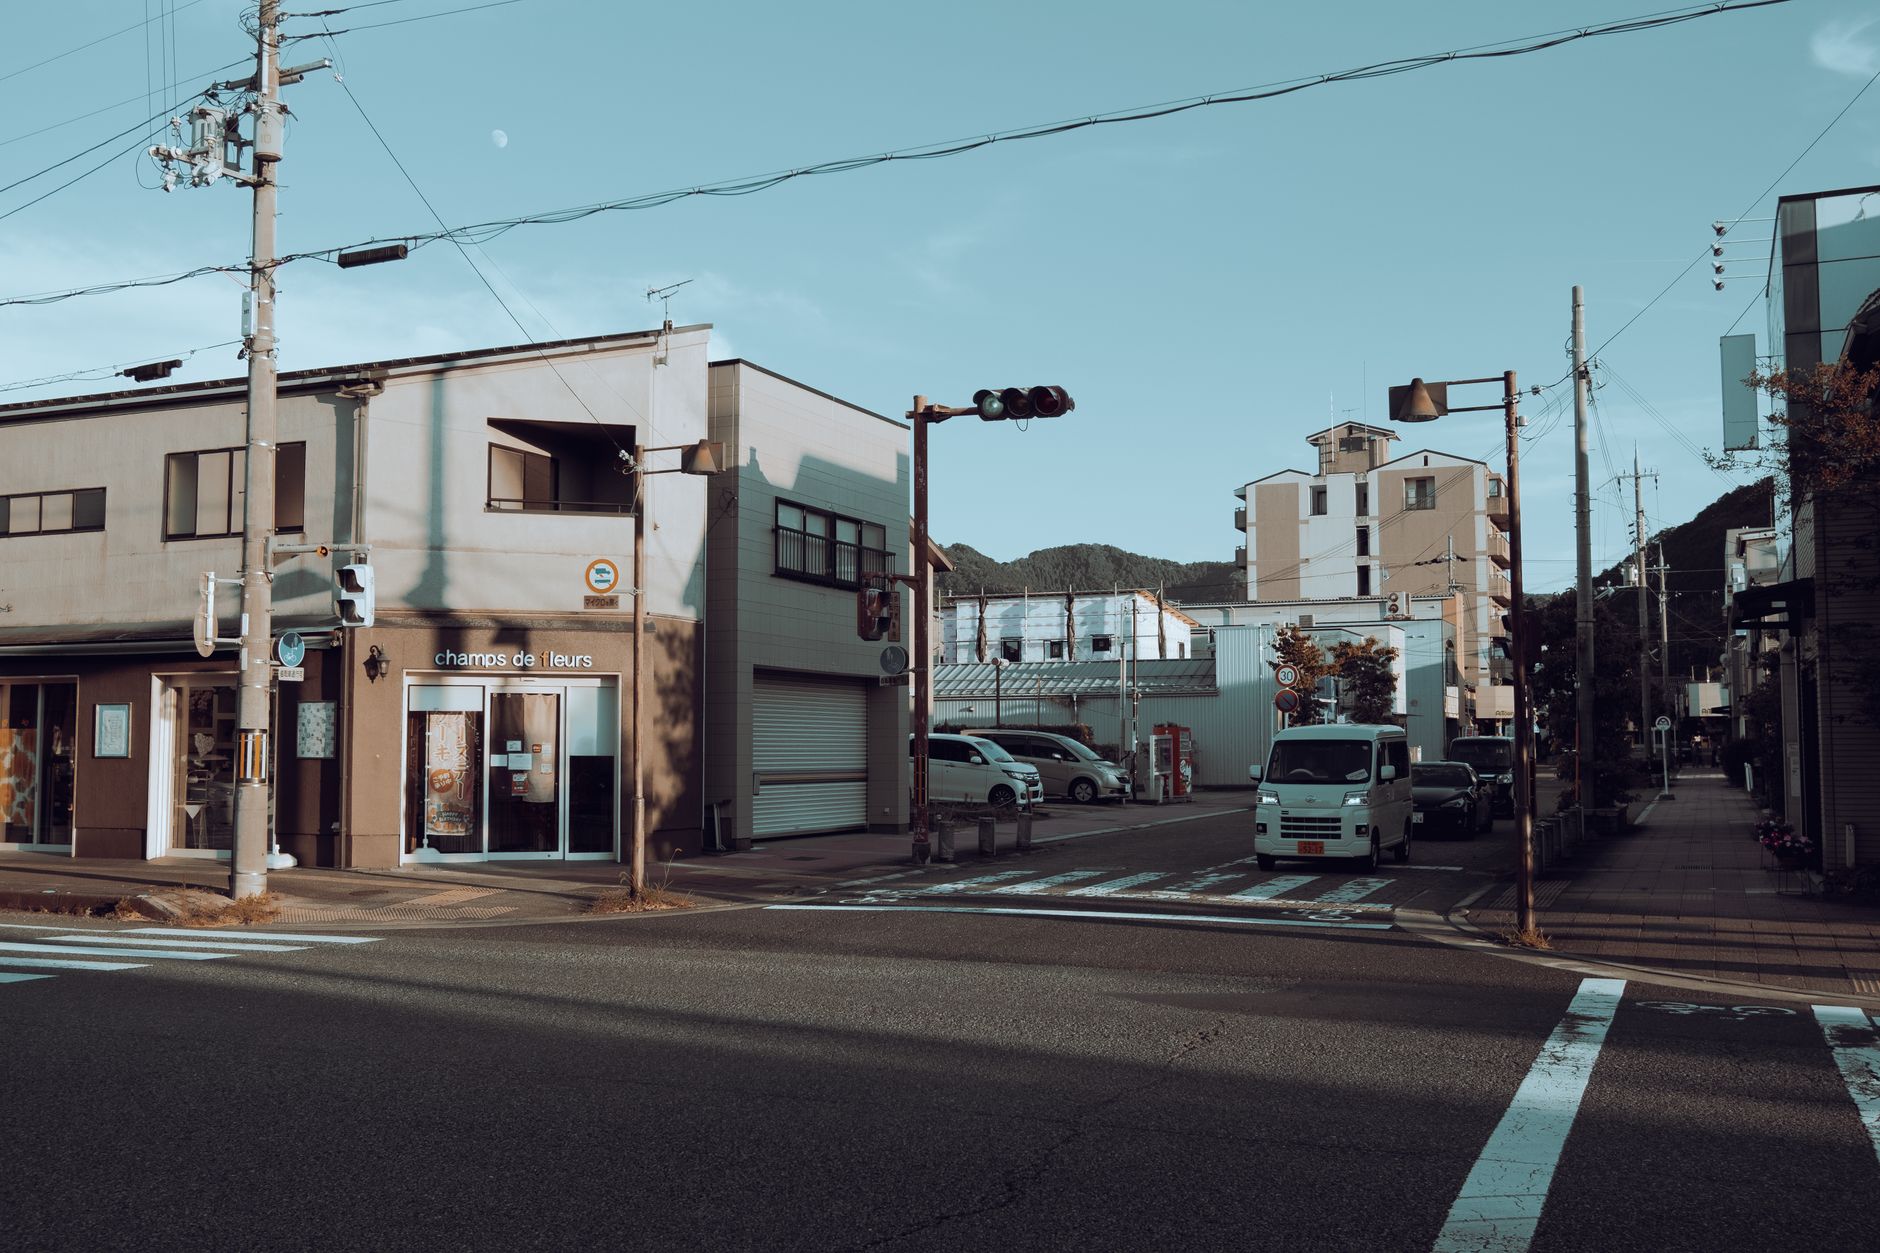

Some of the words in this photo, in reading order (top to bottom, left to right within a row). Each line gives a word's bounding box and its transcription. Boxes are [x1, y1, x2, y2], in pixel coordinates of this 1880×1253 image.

[434, 648, 507, 668] champs
[512, 650, 535, 667] de
[540, 651, 593, 668] fleurs
[1280, 670, 1293, 681] 30
